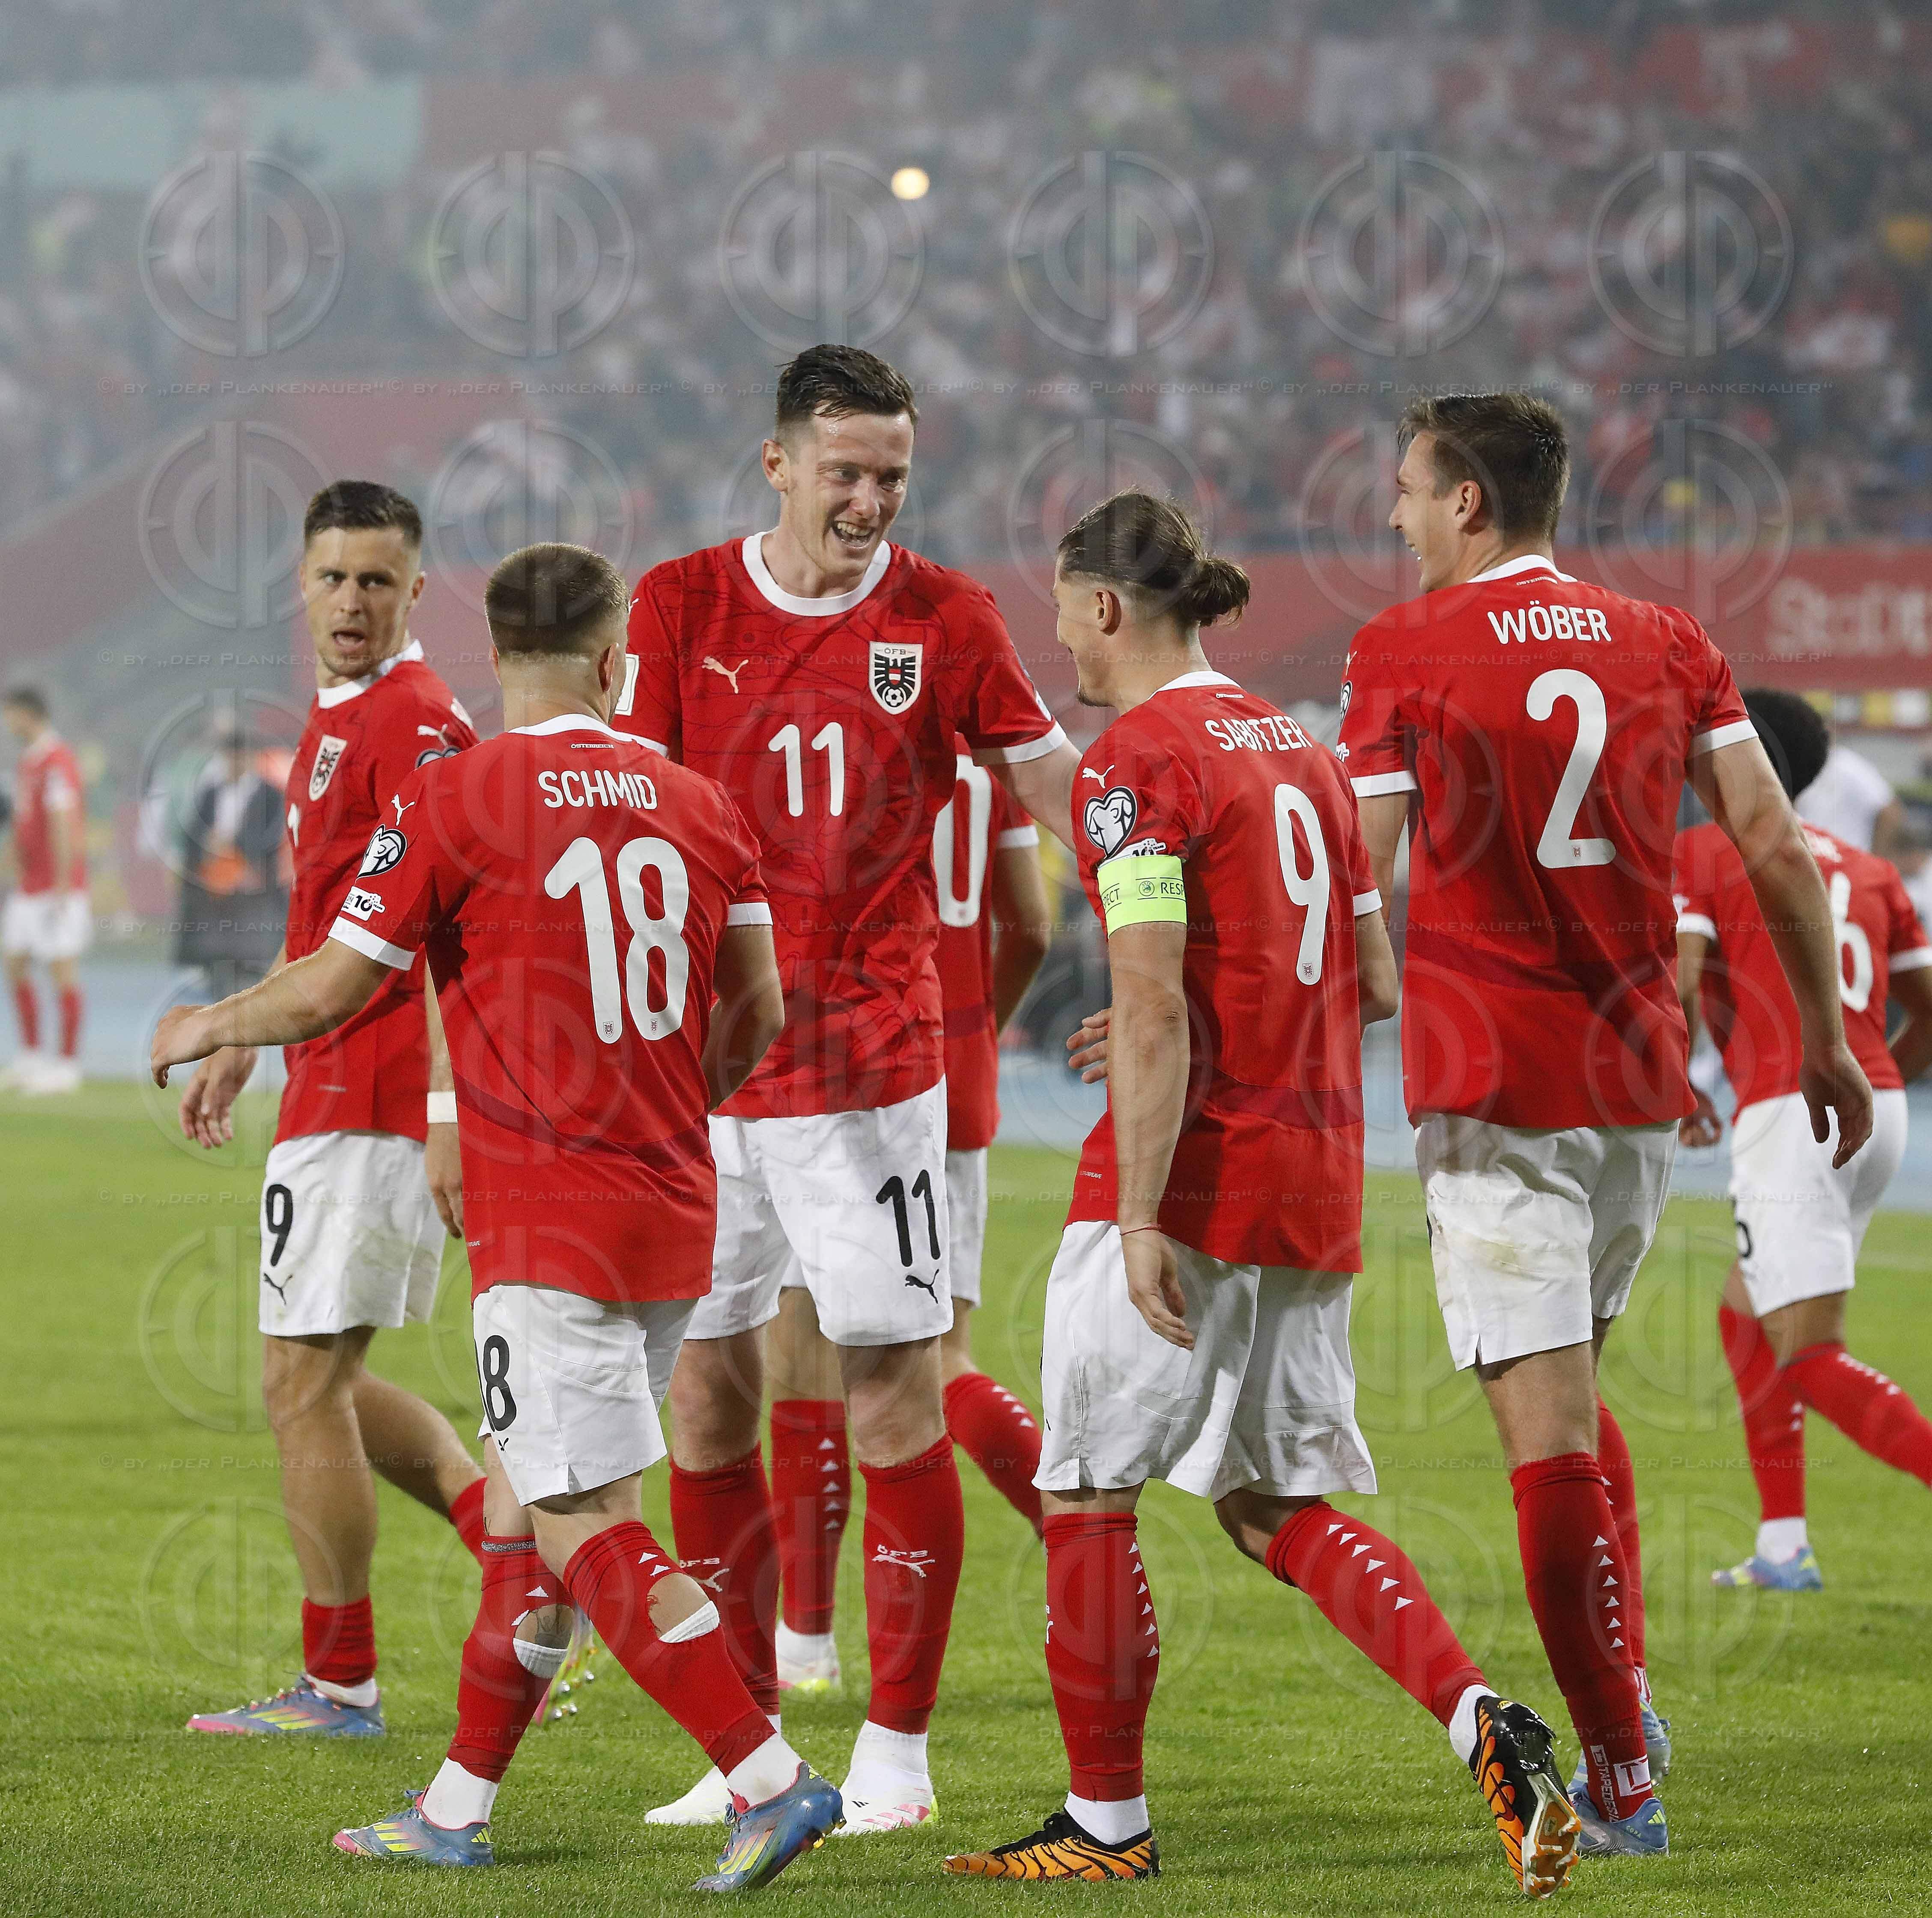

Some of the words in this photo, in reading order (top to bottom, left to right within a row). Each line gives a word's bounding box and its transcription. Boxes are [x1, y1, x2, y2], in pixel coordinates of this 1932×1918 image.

[1487, 600, 1612, 644] WÖBER
[768, 721, 844, 818] 11
[1205, 715, 1313, 752] SABITZER
[1526, 668, 1617, 869] 2
[538, 769, 658, 810] SCHMID
[355, 895, 372, 911] 10
[1274, 783, 1330, 986] 9
[544, 837, 689, 1045] 18
[266, 1184, 294, 1267] 9
[876, 1169, 941, 1267] 11
[477, 1335, 517, 1432] 8
